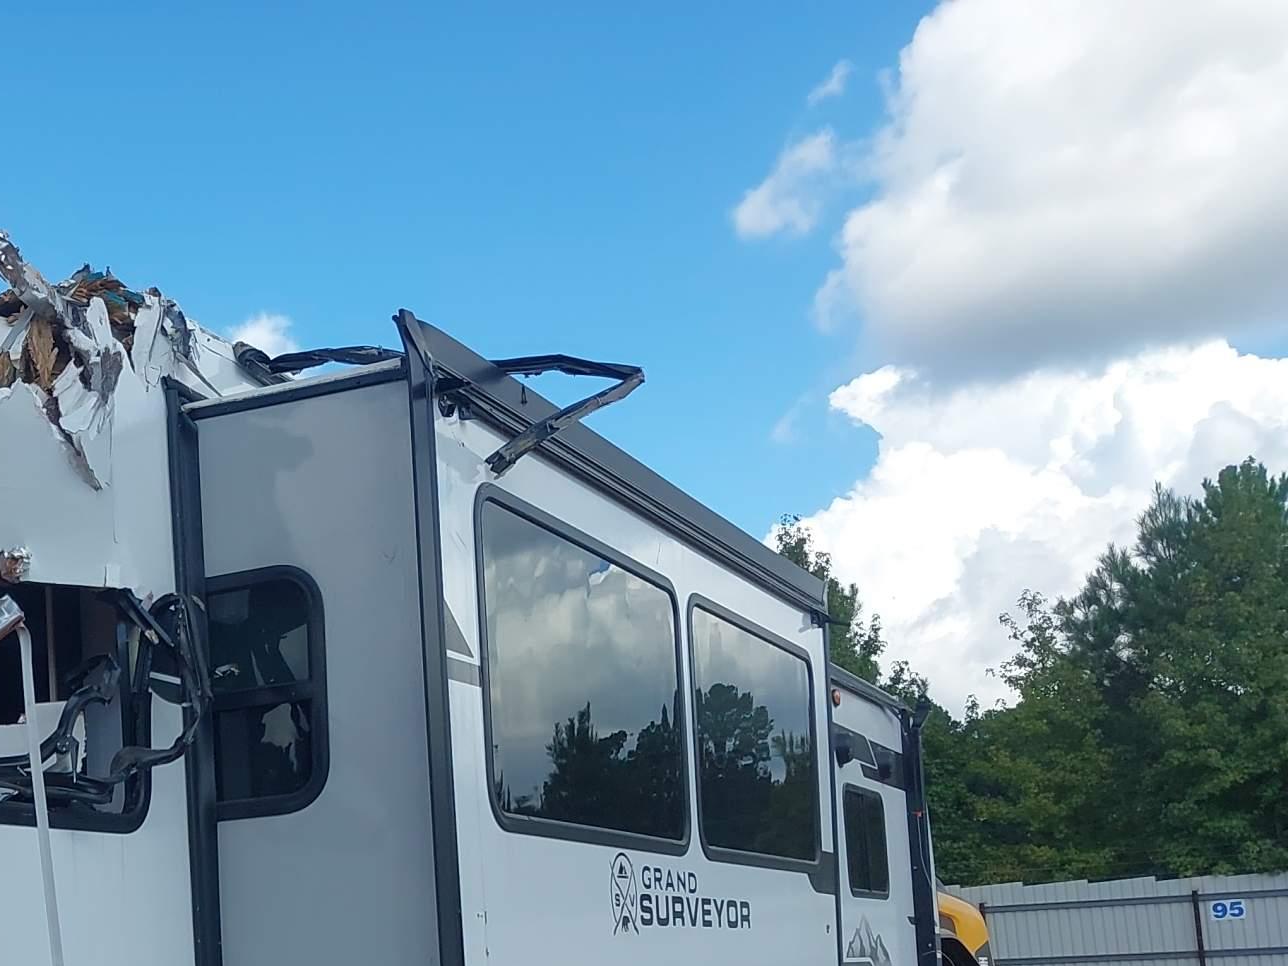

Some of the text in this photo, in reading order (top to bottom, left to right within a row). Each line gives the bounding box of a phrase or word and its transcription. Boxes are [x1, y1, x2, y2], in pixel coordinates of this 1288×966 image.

[641, 865, 698, 894] GRAND
[640, 893, 751, 929] SURVEYOR
[1212, 901, 1245, 919] 95
